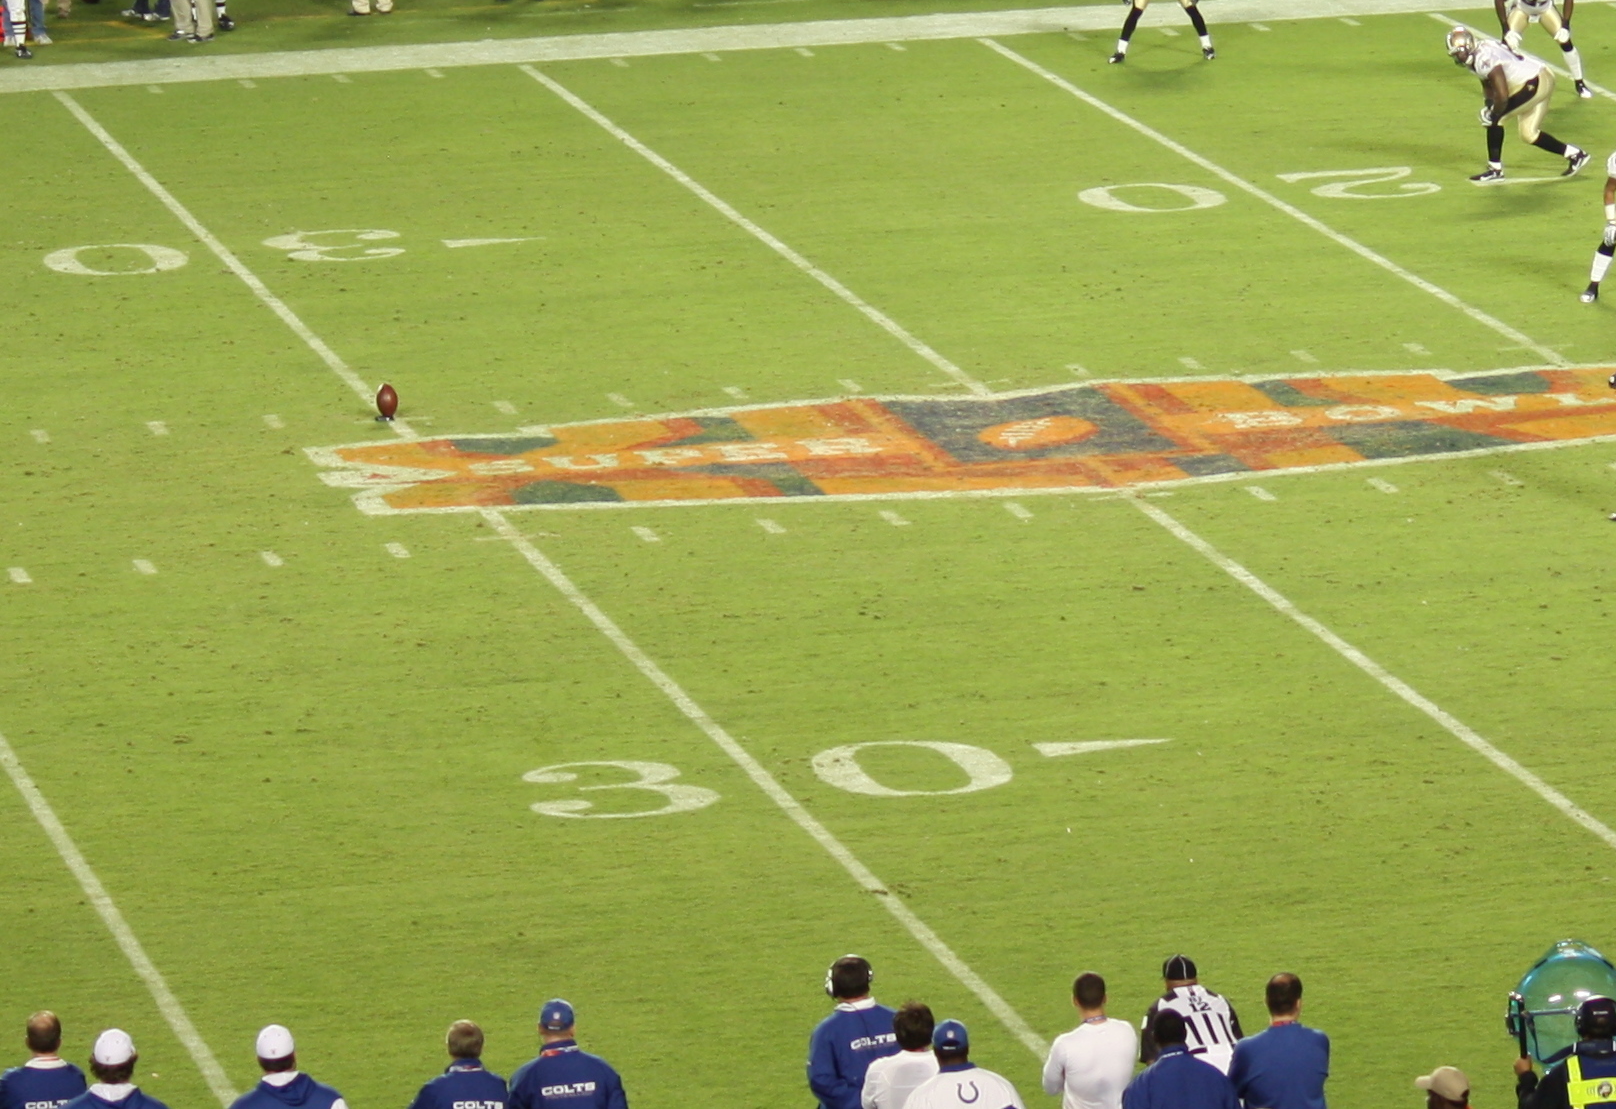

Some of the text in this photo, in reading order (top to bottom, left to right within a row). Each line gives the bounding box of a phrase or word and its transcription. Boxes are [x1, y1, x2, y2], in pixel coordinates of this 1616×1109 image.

[1078, 165, 1441, 212] 20
[43, 228, 406, 276] 30
[469, 436, 886, 476] SUPER
[521, 741, 1013, 818] 30
[1189, 1002, 1211, 1013] 12
[850, 1033, 897, 1050] COLTS
[541, 1081, 597, 1097] COLTS
[25, 1099, 68, 1109] COLT
[453, 1100, 504, 1109] COLTS
